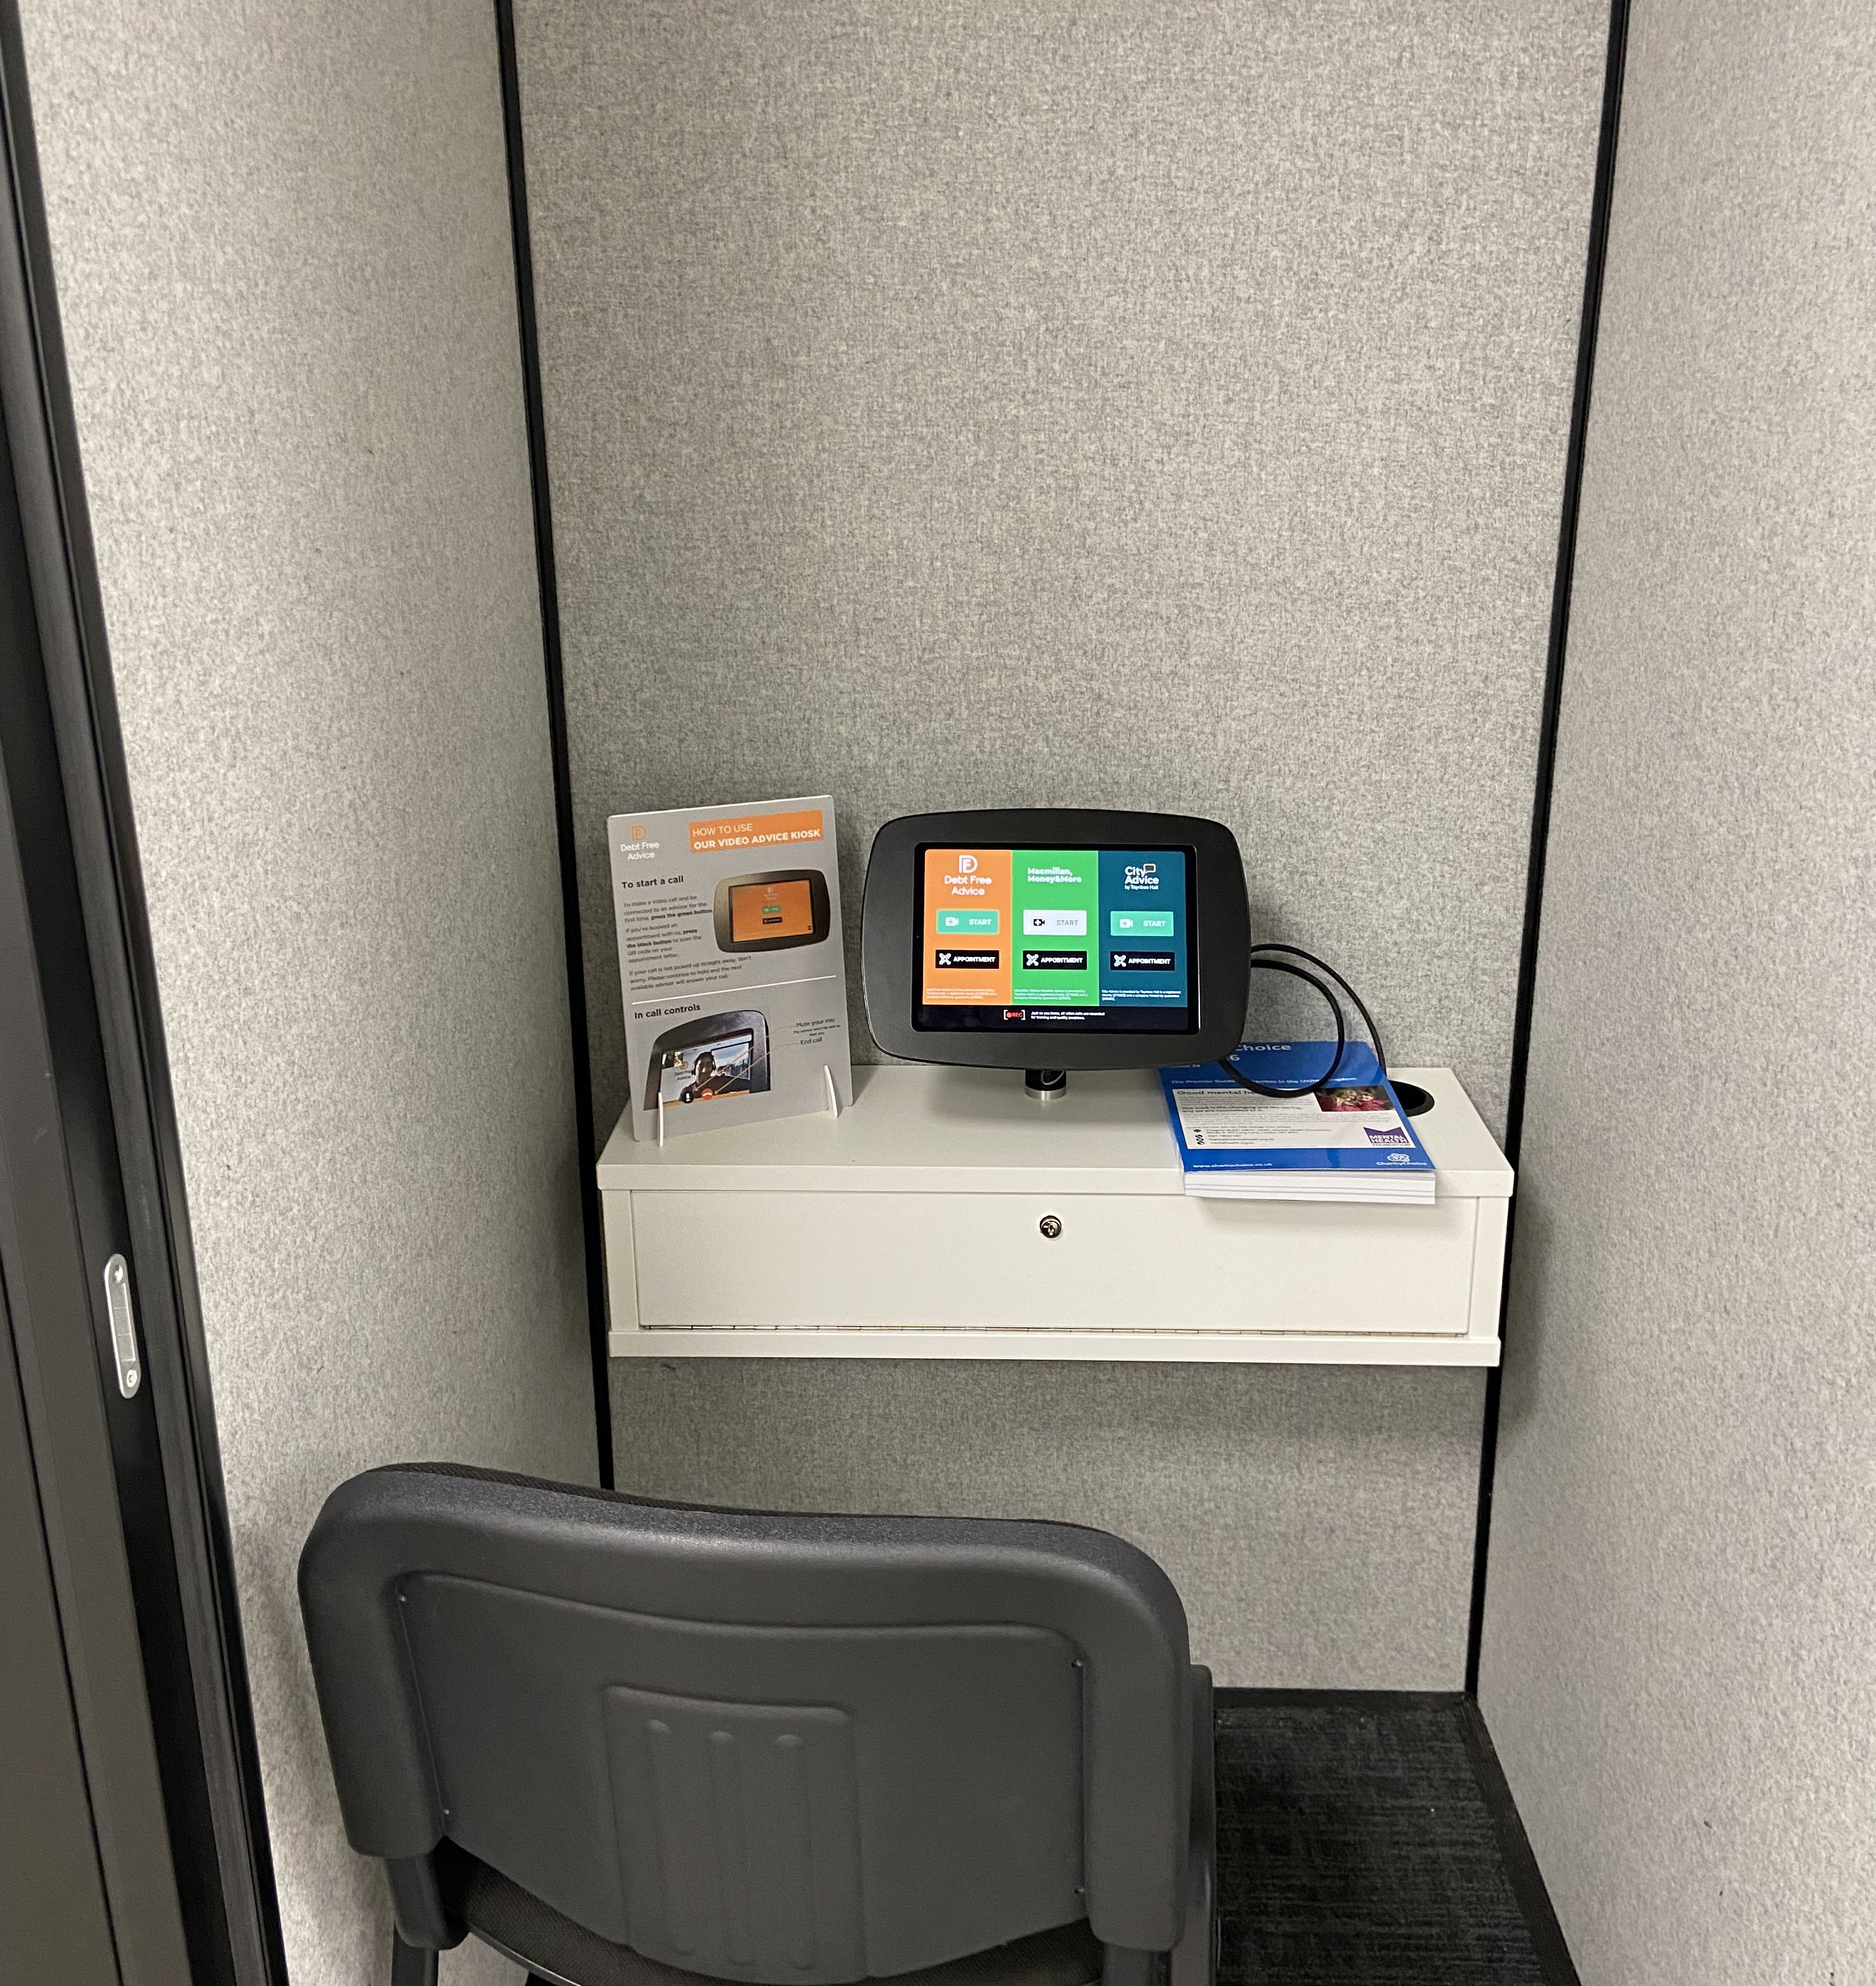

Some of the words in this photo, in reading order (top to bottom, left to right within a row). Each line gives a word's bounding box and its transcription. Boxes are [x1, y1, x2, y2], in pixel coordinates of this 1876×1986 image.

[692, 827, 716, 837] HOW
[718, 826, 731, 834] TO
[734, 823, 753, 832] USE
[694, 840, 716, 850] OUR
[718, 836, 749, 847] VIDEO
[752, 832, 788, 844] ADVICE
[790, 829, 821, 840] KIOSK
[621, 843, 640, 852] Debt
[642, 842, 659, 850] Free
[627, 852, 655, 860] Advice
[1027, 866, 1072, 876] Macmillan,
[1125, 866, 1146, 877] City
[636, 878, 658, 888] start
[668, 875, 684, 884] call
[944, 875, 968, 884] Debt
[970, 875, 992, 884] Free
[1027, 875, 1082, 884] Money&More
[1125, 876, 1159, 884] Advice
[951, 886, 985, 896] Advice
[1143, 919, 1166, 927] START
[634, 1010, 643, 1020] In
[645, 1009, 662, 1018] call
[664, 1004, 701, 1015] controls
